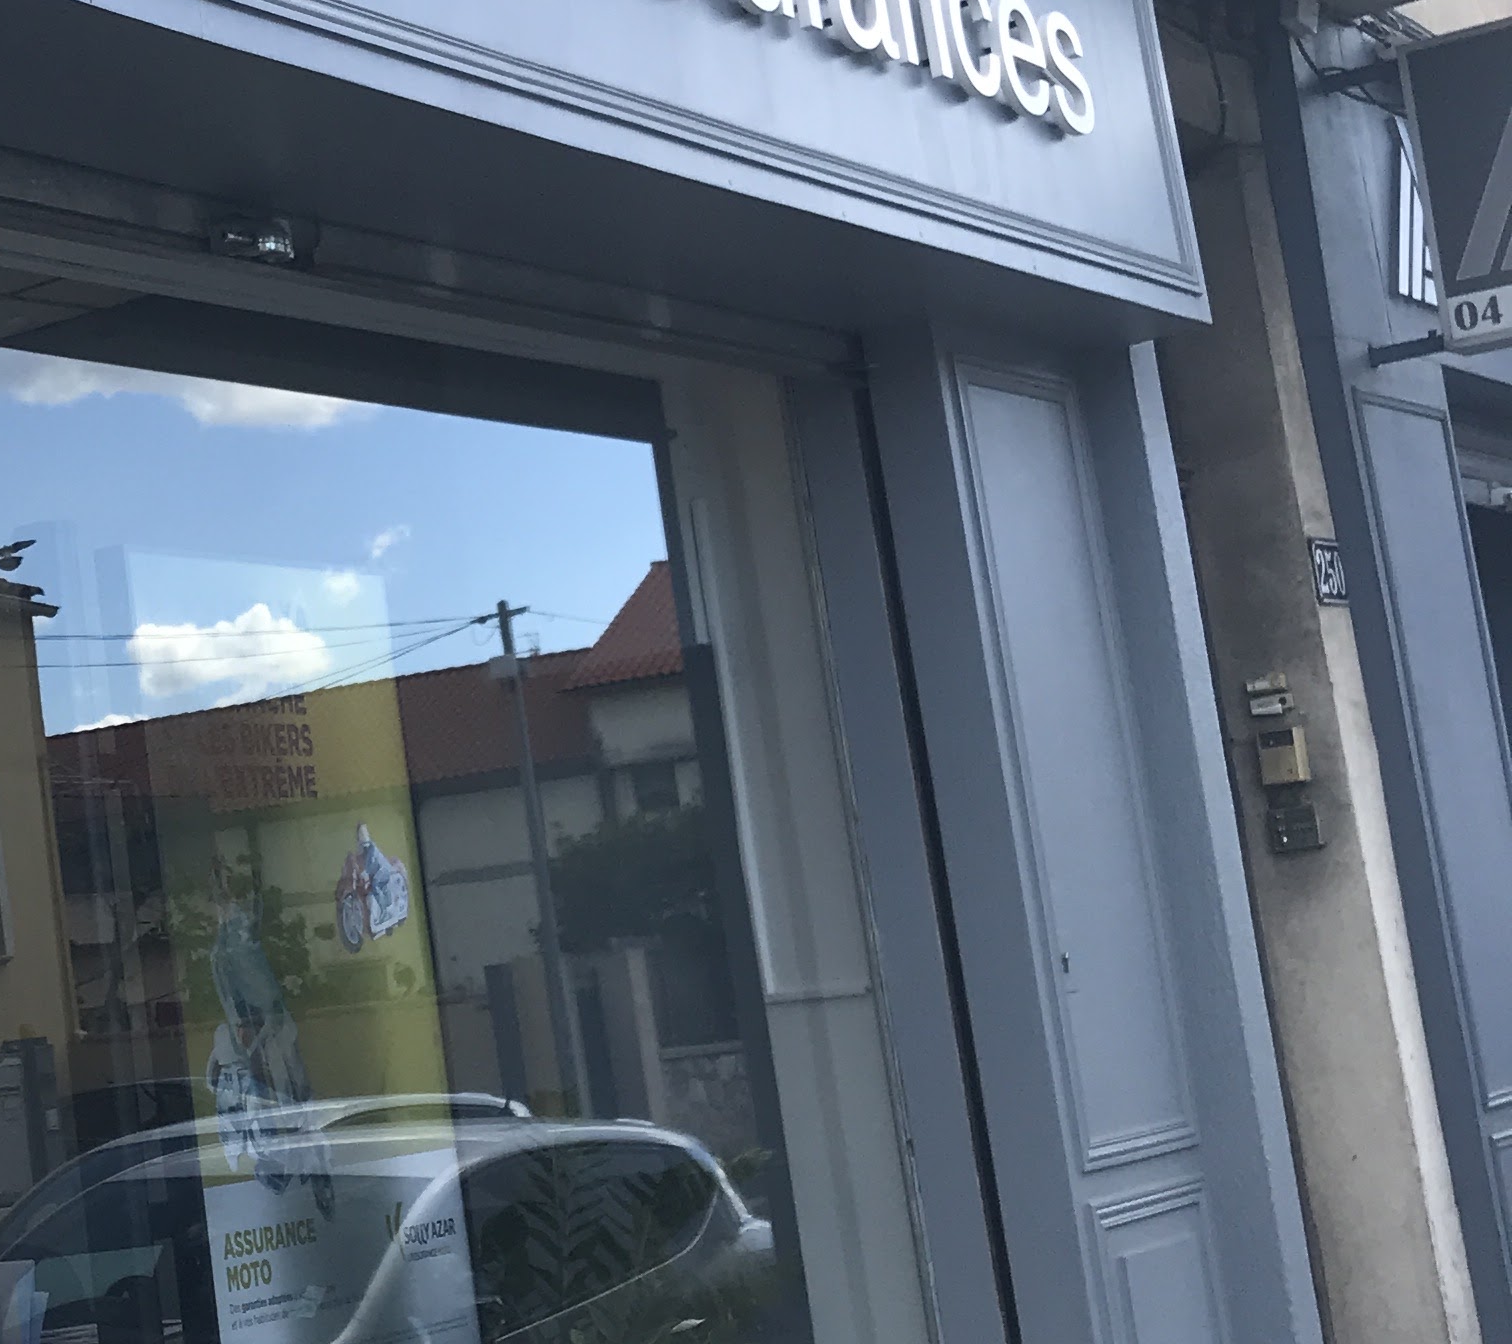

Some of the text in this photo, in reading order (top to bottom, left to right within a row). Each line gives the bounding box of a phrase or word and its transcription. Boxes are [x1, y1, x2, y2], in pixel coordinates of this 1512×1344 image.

[1454, 295, 1503, 331] 04
[1315, 548, 1346, 596] 250
[241, 723, 314, 757] BIKERS
[223, 1218, 318, 1260] ASSURANCE
[226, 1259, 273, 1293] MOTO
